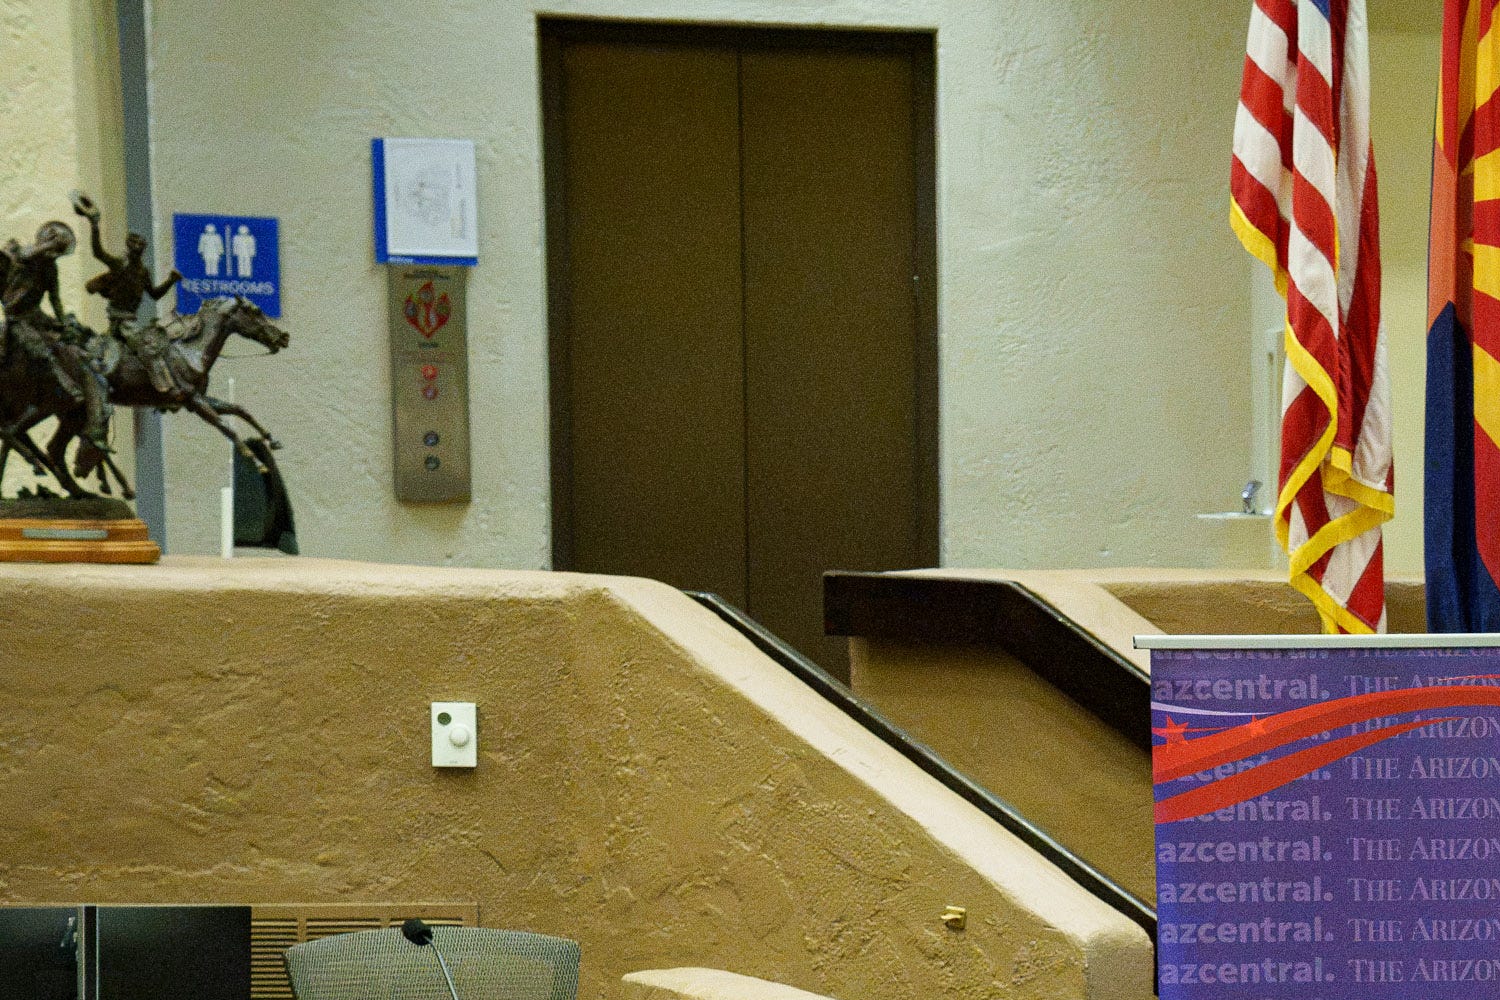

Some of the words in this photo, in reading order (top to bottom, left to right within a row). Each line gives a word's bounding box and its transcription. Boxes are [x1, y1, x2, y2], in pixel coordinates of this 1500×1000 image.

[1154, 674, 1331, 700] azcentral.
[1345, 756, 1401, 780] THE
[1346, 796, 1401, 821] THE
[1158, 835, 1333, 863] azcentral.
[1346, 836, 1402, 862] THE
[1159, 876, 1334, 903] azcentral.
[1347, 877, 1402, 902] THE
[1160, 916, 1335, 944] azcentral.
[1347, 918, 1403, 942] THE
[1160, 957, 1335, 985] azcentral.
[1347, 958, 1404, 983] THE
